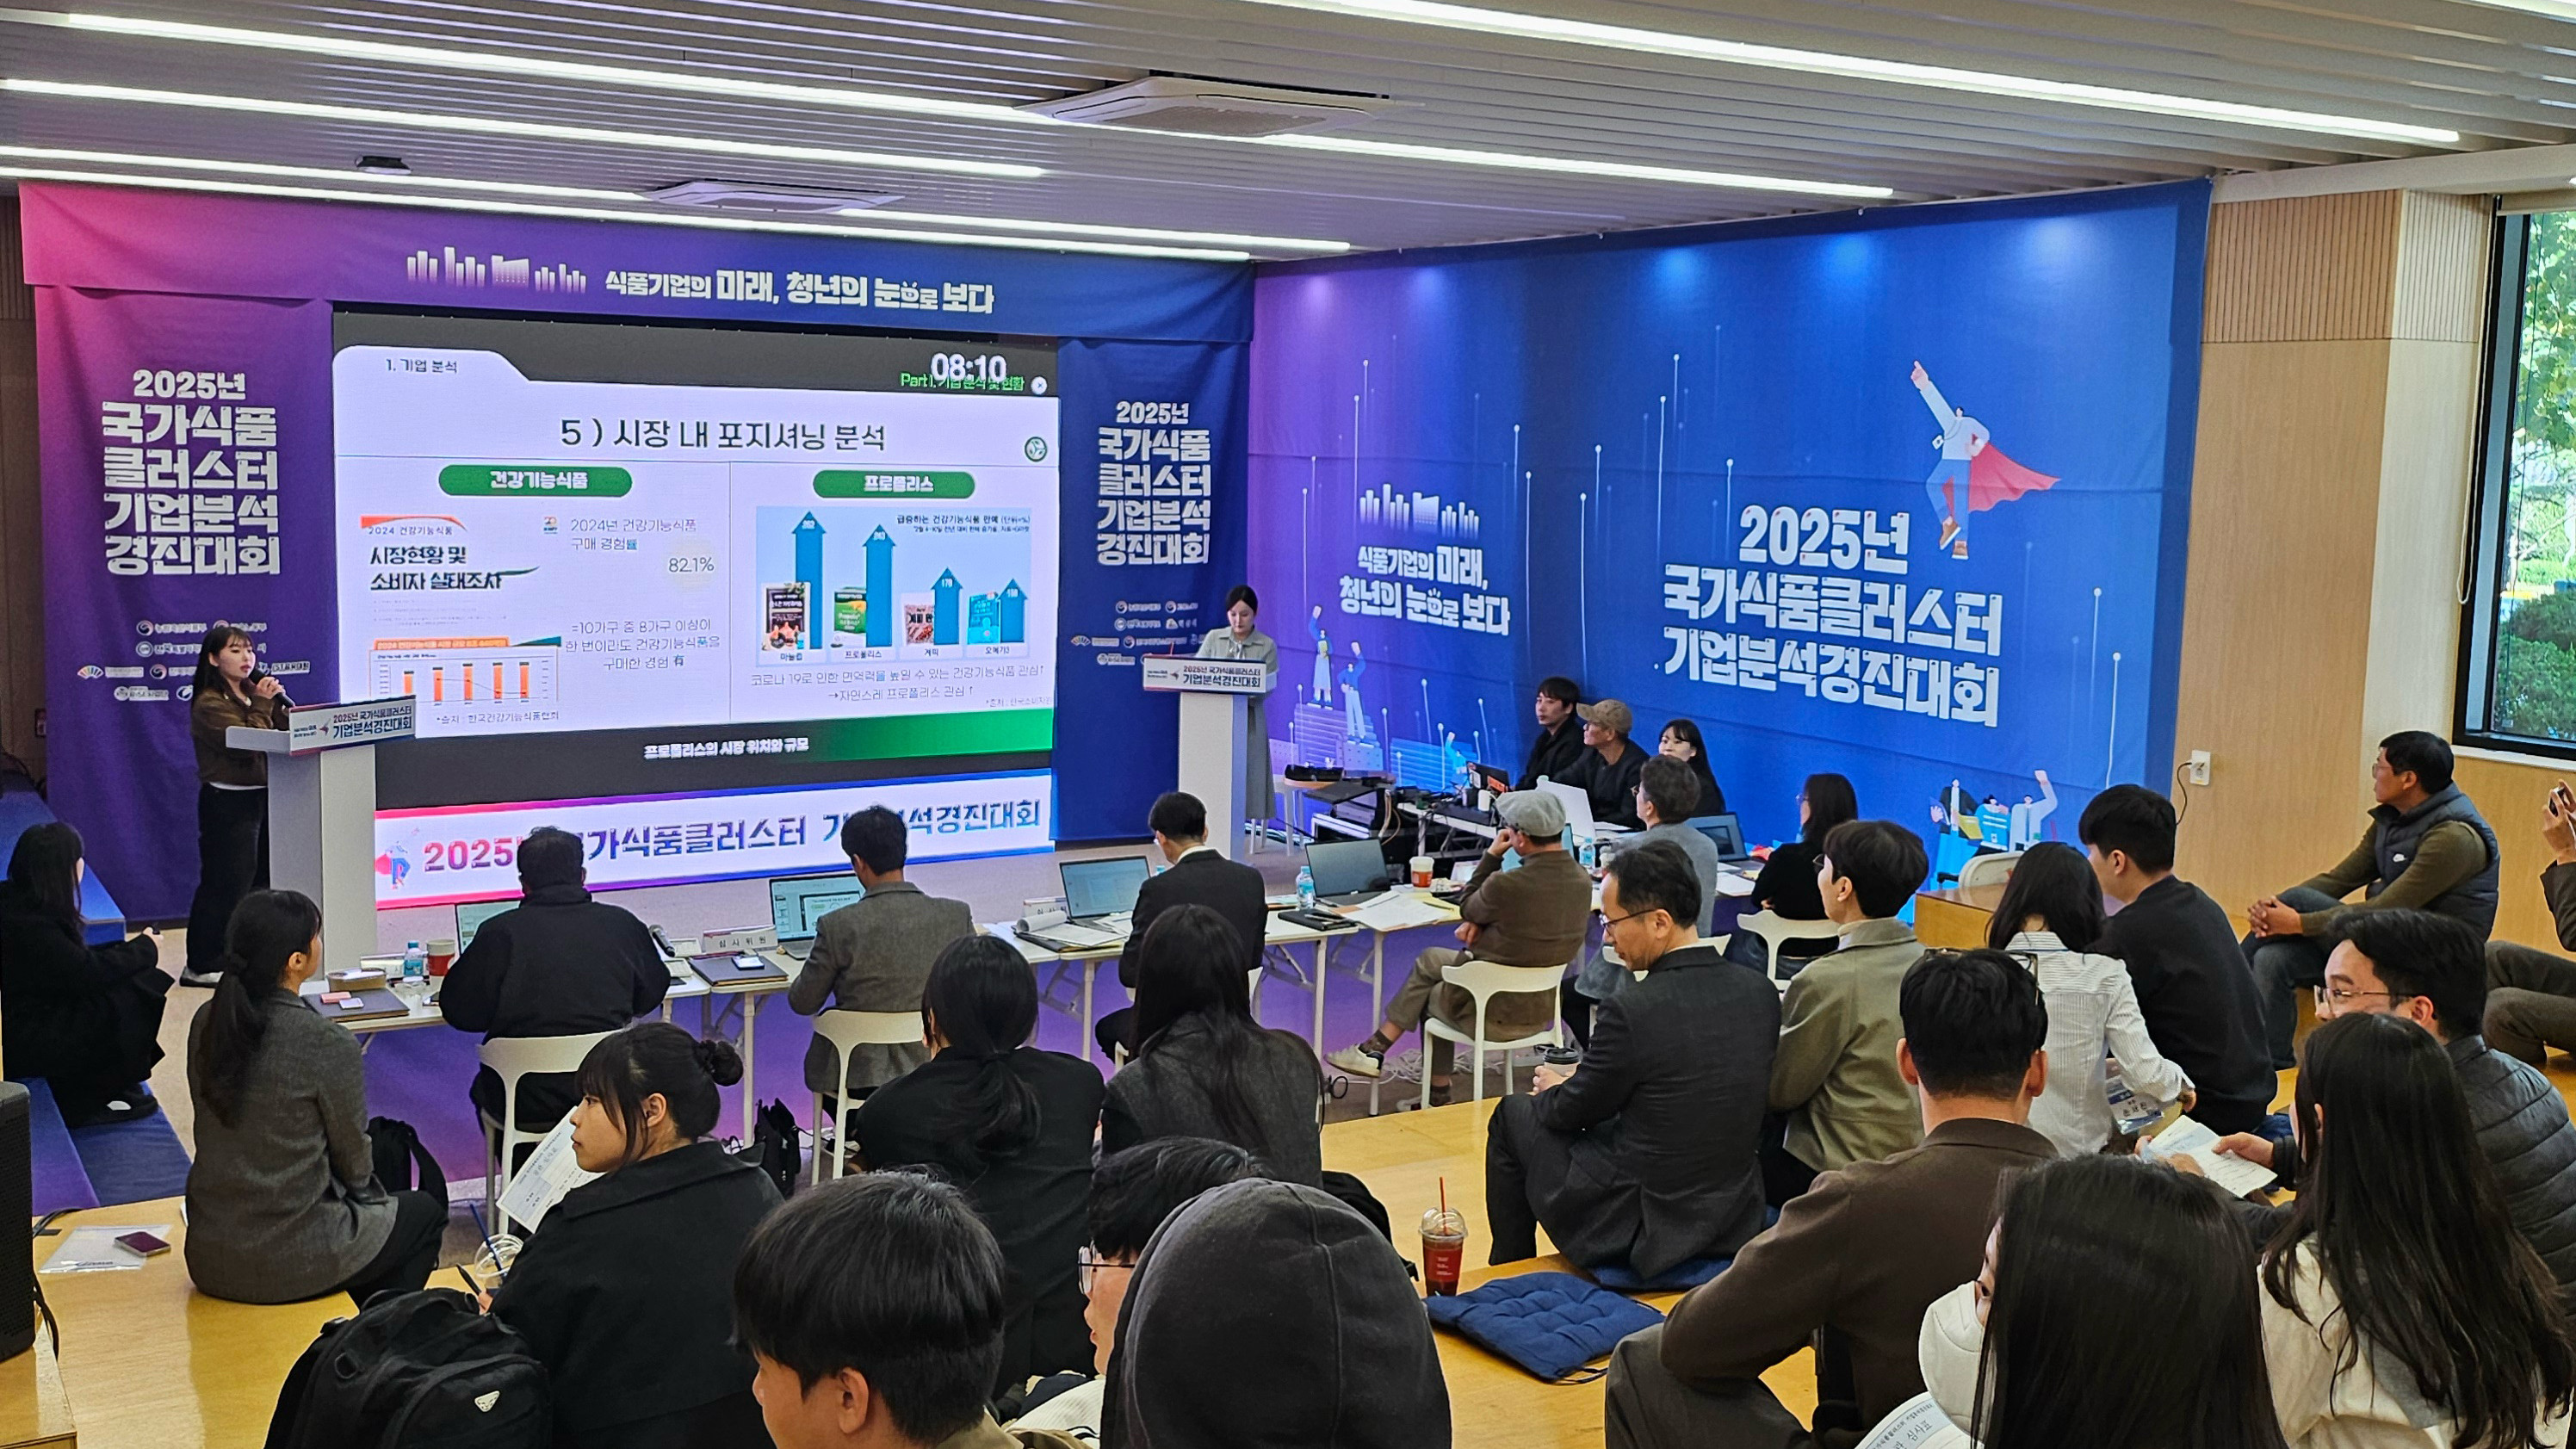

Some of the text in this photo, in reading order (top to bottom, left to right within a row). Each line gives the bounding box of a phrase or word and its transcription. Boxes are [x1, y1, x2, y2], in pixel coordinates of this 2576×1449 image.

[605, 269, 995, 313] 식품기업의 미래, 청년의 눈으로 보다
[400, 358, 428, 373] 기업
[431, 359, 458, 374] 분석
[900, 372, 928, 387] Part
[931, 352, 1007, 382] 08:10
[133, 369, 246, 400] 2025년
[102, 401, 277, 446] 국가식품
[1116, 400, 1190, 424] 2025년
[614, 418, 670, 448] 시장
[678, 419, 709, 449] 내
[717, 421, 826, 450] 포지셔닝
[835, 424, 885, 451] 분석
[1098, 426, 1211, 461] 국가식품
[103, 446, 279, 490] 클러스터
[490, 470, 589, 490] 건강기능식품
[1099, 462, 1211, 497] 클러스터
[864, 475, 935, 493] 프로폴리스
[103, 492, 279, 533] 기업분석
[571, 518, 618, 532] 2024년
[623, 518, 697, 532] 건강기능식품
[1097, 499, 1211, 531] 기업분석
[368, 526, 453, 536] 2024 건강기능식품
[571, 538, 596, 550] 구매
[1738, 505, 1910, 575] 2025년
[105, 535, 281, 575] 경진대회
[370, 546, 467, 565] 시장현황 및
[1097, 532, 1211, 566] 경진대회
[668, 556, 715, 573] 82.1%
[1357, 545, 1489, 591] 식품기업의 미래,
[370, 572, 502, 591] 소비자 실태조사
[1340, 575, 1511, 635] 청년의 눈으로 보다
[1663, 563, 2003, 657] 국가식품클러스터
[623, 621, 635, 634] 중
[639, 620, 672, 634] 8가구
[675, 618, 711, 631] 이상이
[566, 635, 720, 653] 한 번이라도 건강기능식품을
[645, 656, 669, 669] 경험
[751, 674, 785, 686] 코로나
[789, 672, 812, 685] 19로
[817, 672, 839, 684] 인한
[914, 670, 925, 680] 수
[928, 668, 950, 680] 있는
[952, 666, 1016, 678] 건강기능식품
[1182, 673, 1261, 688] 기업분석경진대회
[1663, 626, 2000, 728] 기업분석경진대회
[332, 716, 412, 739] 기업분석경진대회
[643, 737, 809, 759] 프로폴리스의 시장 위치와 규모
[423, 798, 1041, 873] 2025 가식품클러스터 기석경진대회
